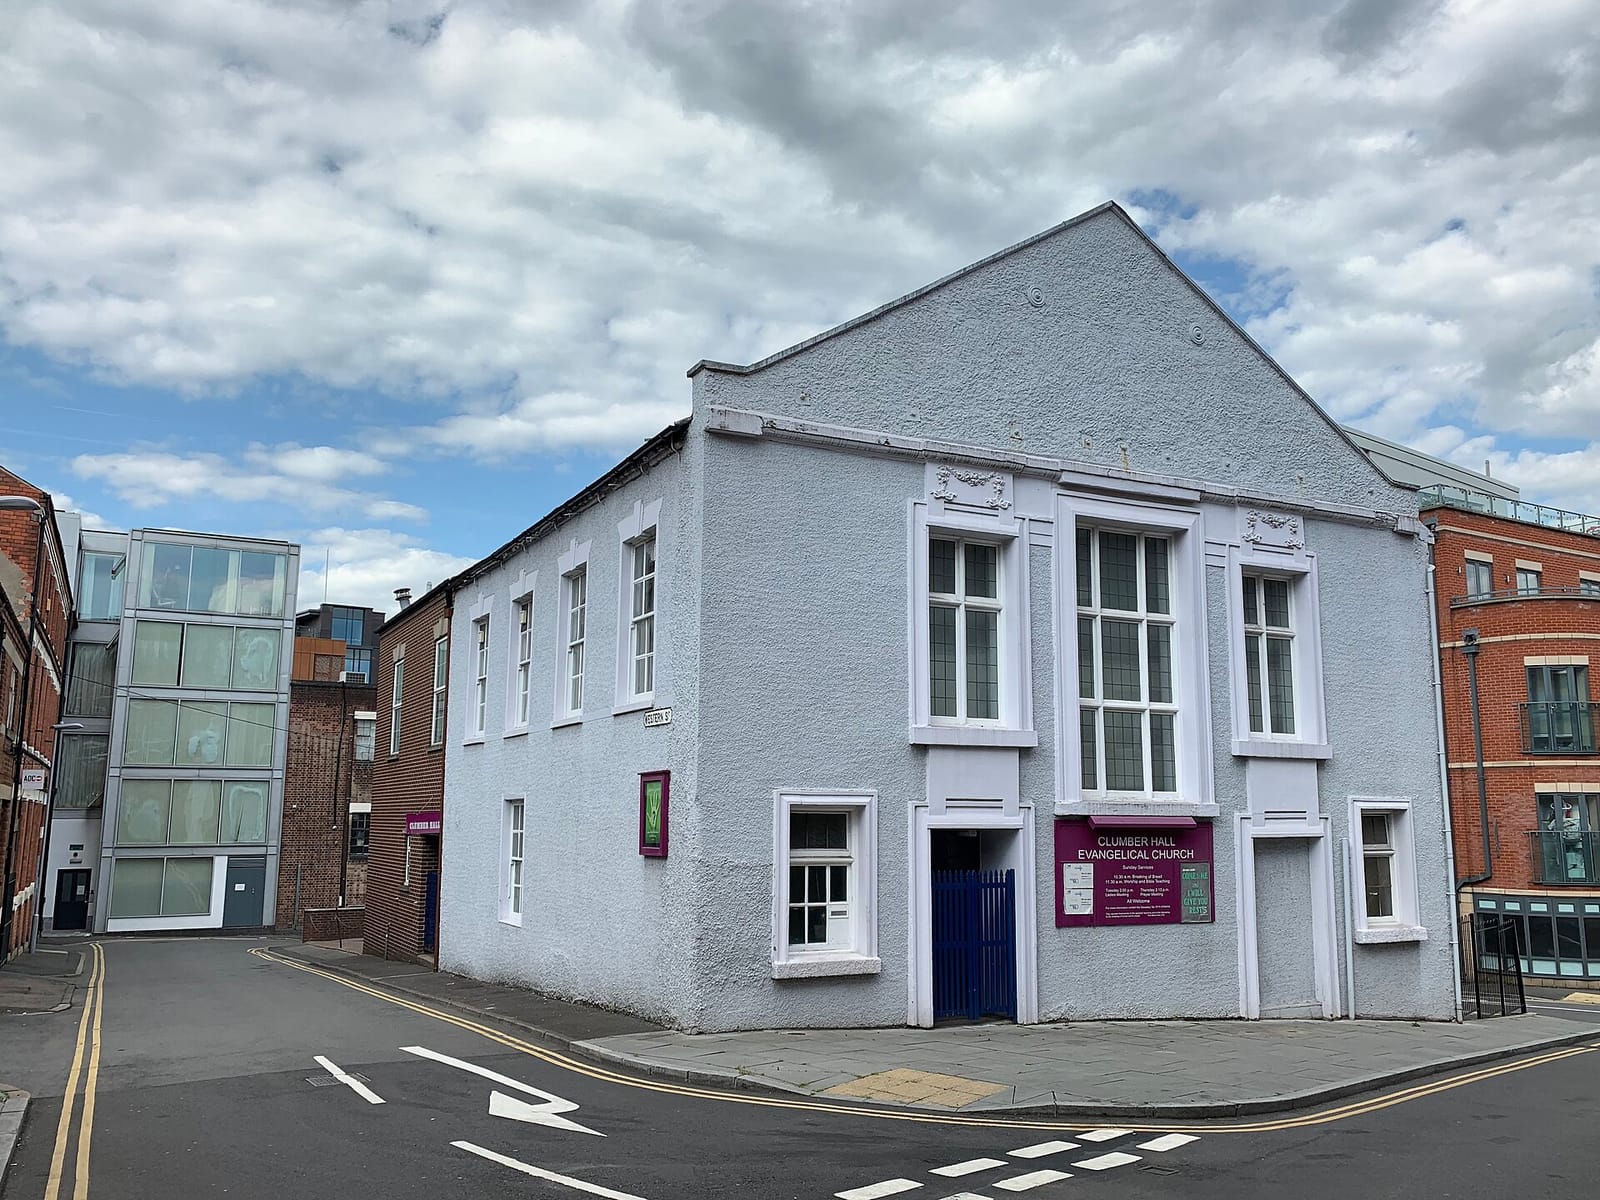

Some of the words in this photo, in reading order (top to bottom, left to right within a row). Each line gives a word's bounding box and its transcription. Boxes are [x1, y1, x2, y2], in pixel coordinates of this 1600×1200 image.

[1098, 836, 1149, 847] CLUMBER
[1151, 837, 1176, 847] HALL
[1078, 849, 1150, 860] EVANGELICAL
[1151, 849, 1194, 859] CHURCH
